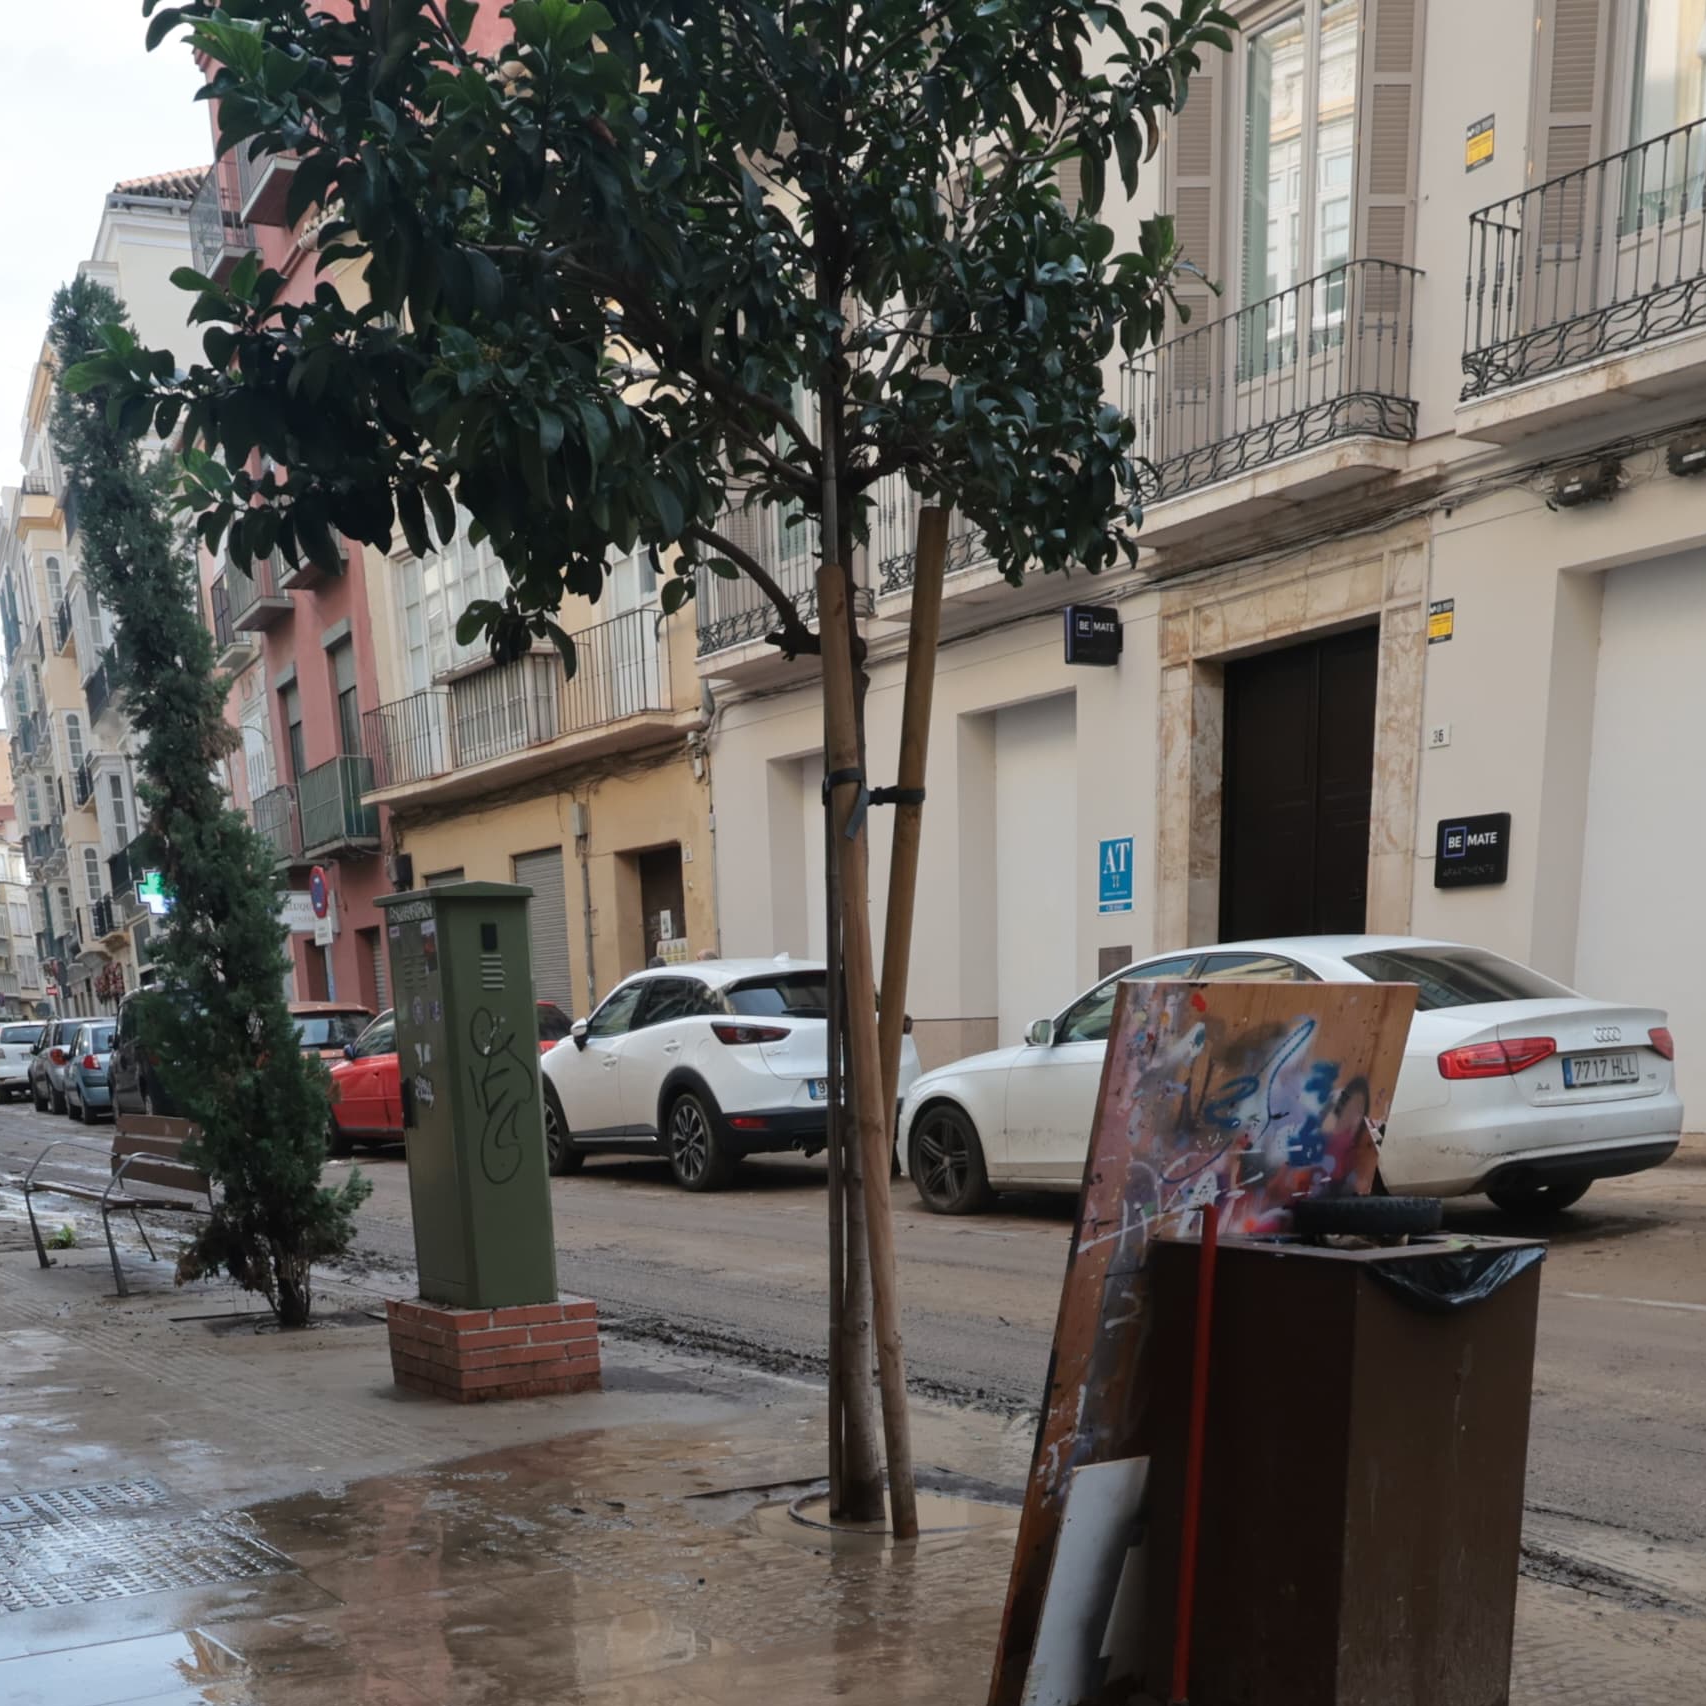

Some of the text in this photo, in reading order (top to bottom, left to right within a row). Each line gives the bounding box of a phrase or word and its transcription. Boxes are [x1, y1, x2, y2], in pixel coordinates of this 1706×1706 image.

[1079, 620, 1115, 633] BE MATE
[1448, 831, 1497, 849] BE MATE
[1102, 842, 1130, 874] AT
[1574, 1056, 1636, 1081] 7717 HLL
